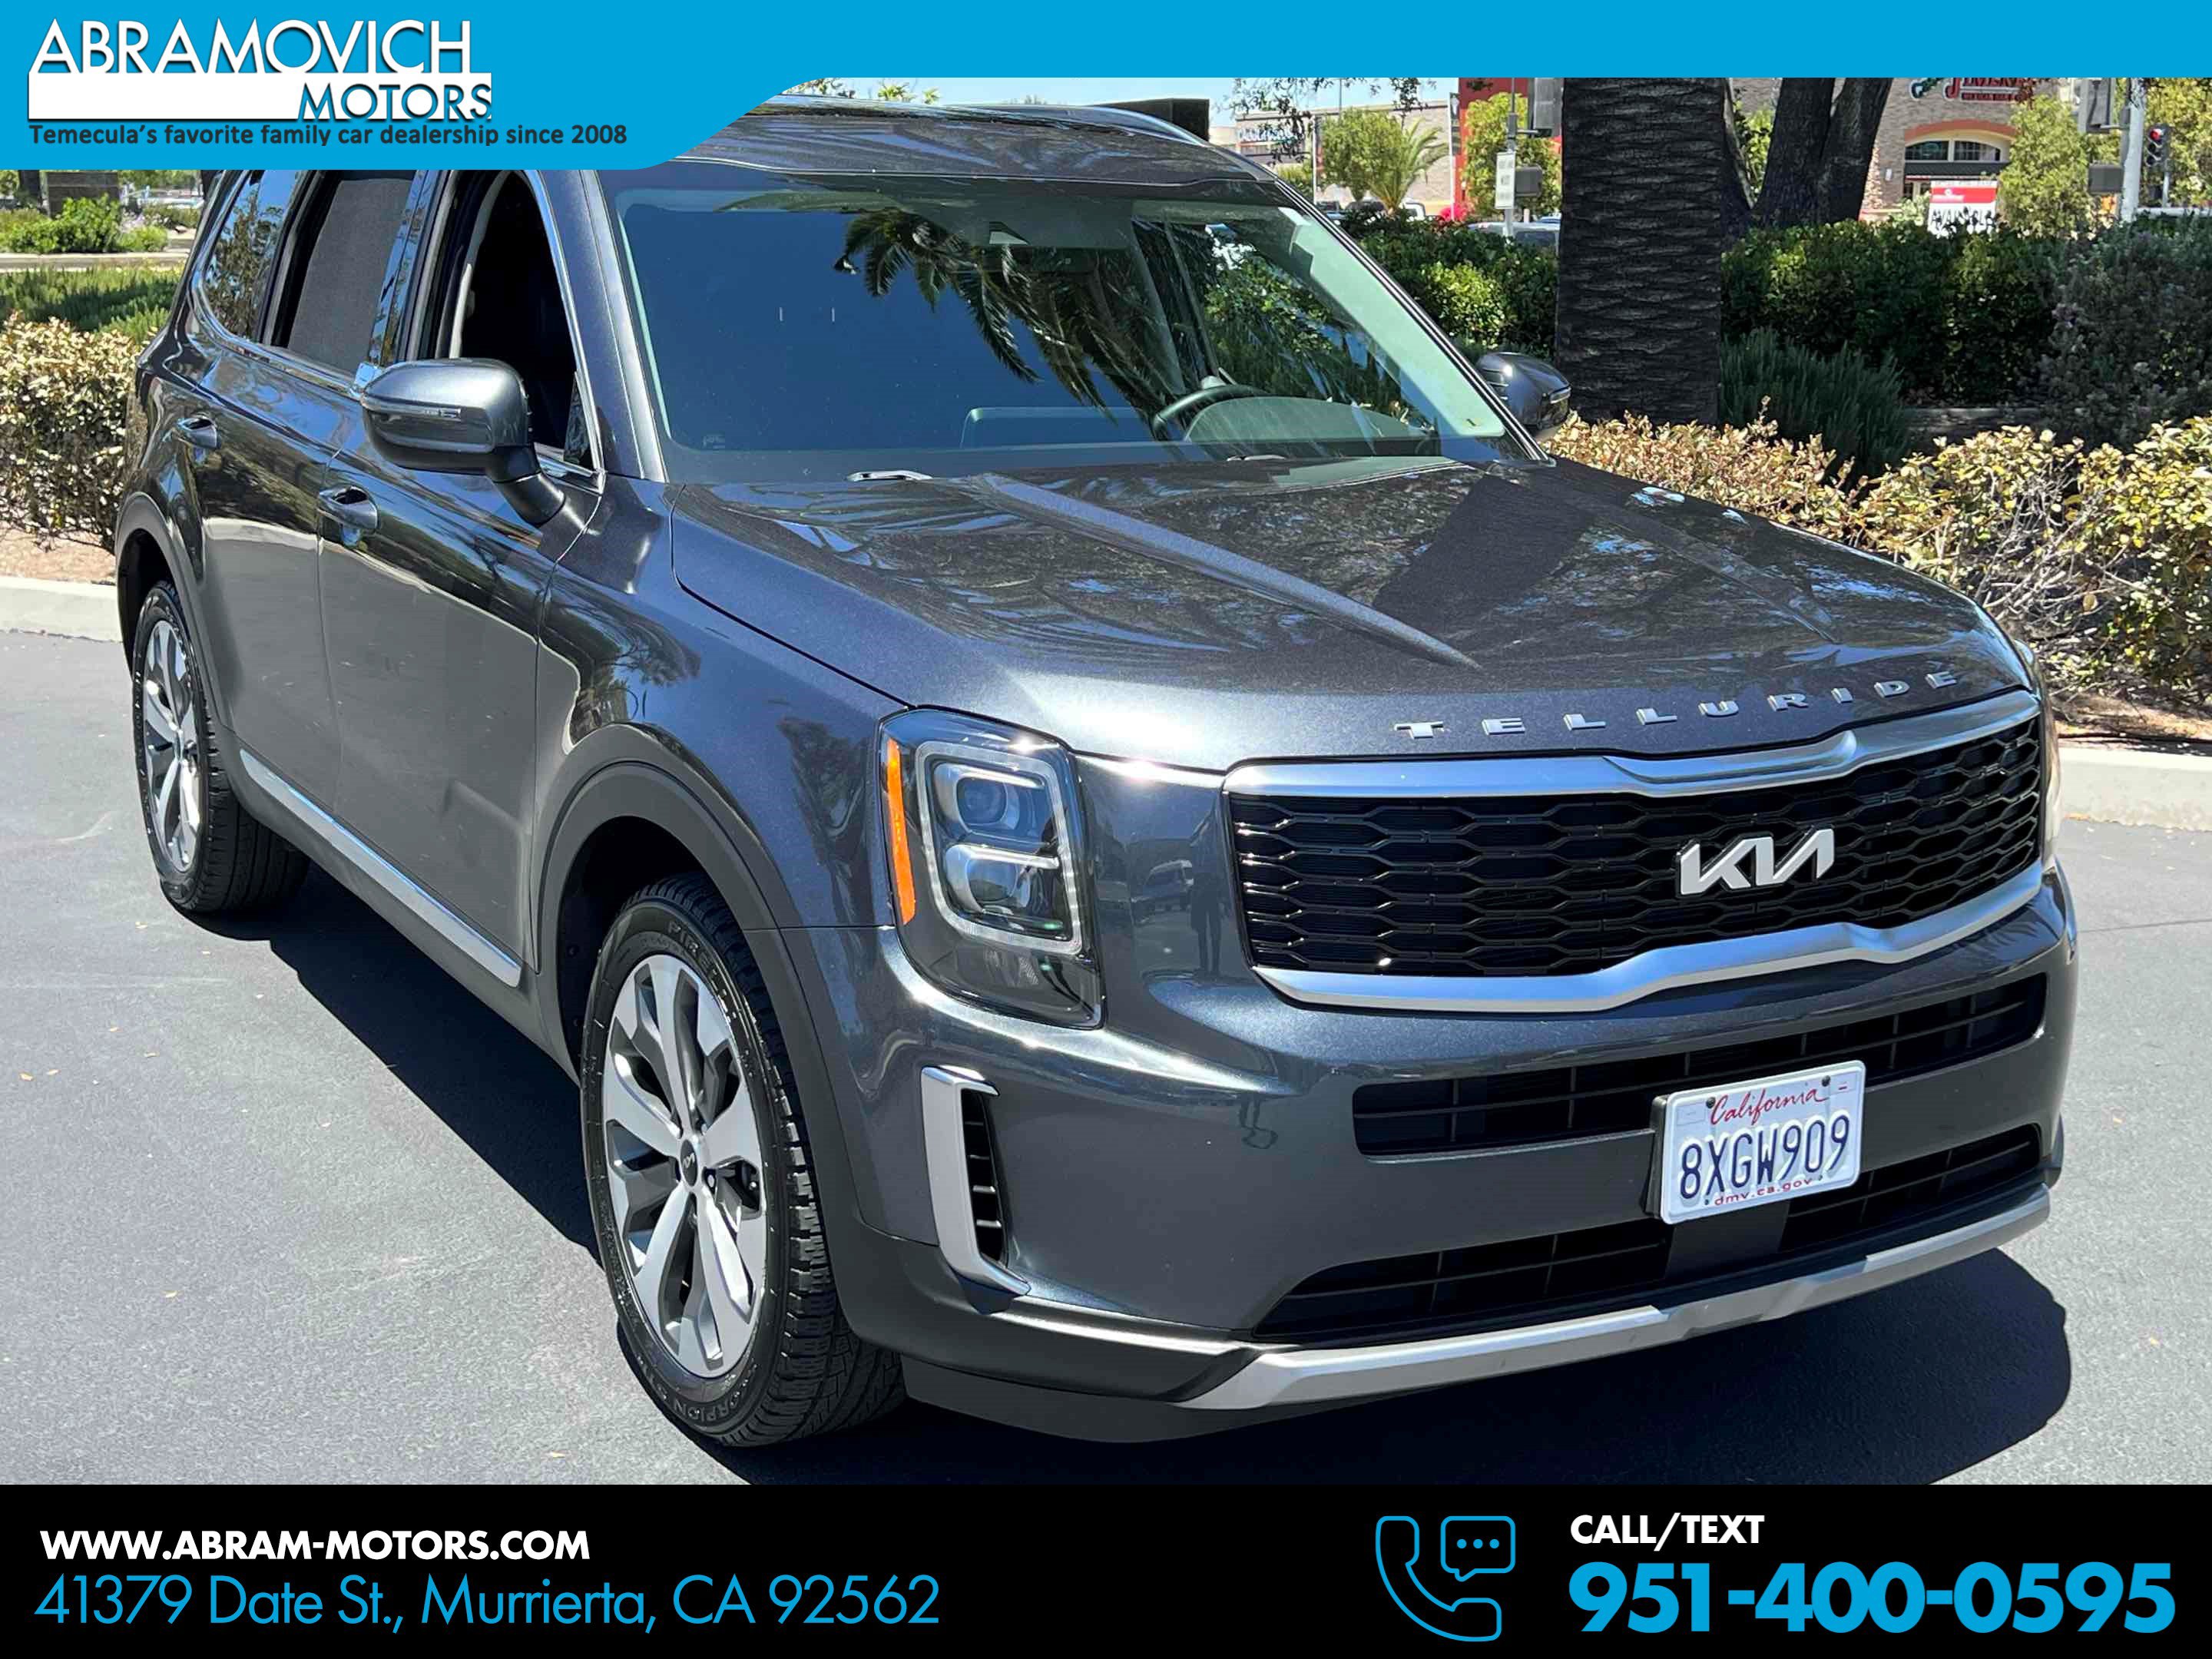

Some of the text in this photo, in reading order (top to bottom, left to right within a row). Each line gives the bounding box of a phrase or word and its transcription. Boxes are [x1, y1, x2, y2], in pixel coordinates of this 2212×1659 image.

[1393, 670, 1958, 739] TELLURIDE
[1678, 828, 1835, 896] KIA
[1710, 1087, 1830, 1126] California
[1680, 1114, 1850, 1200] 8XGW909
[1714, 1177, 1813, 1207] dmv.ca.gov
